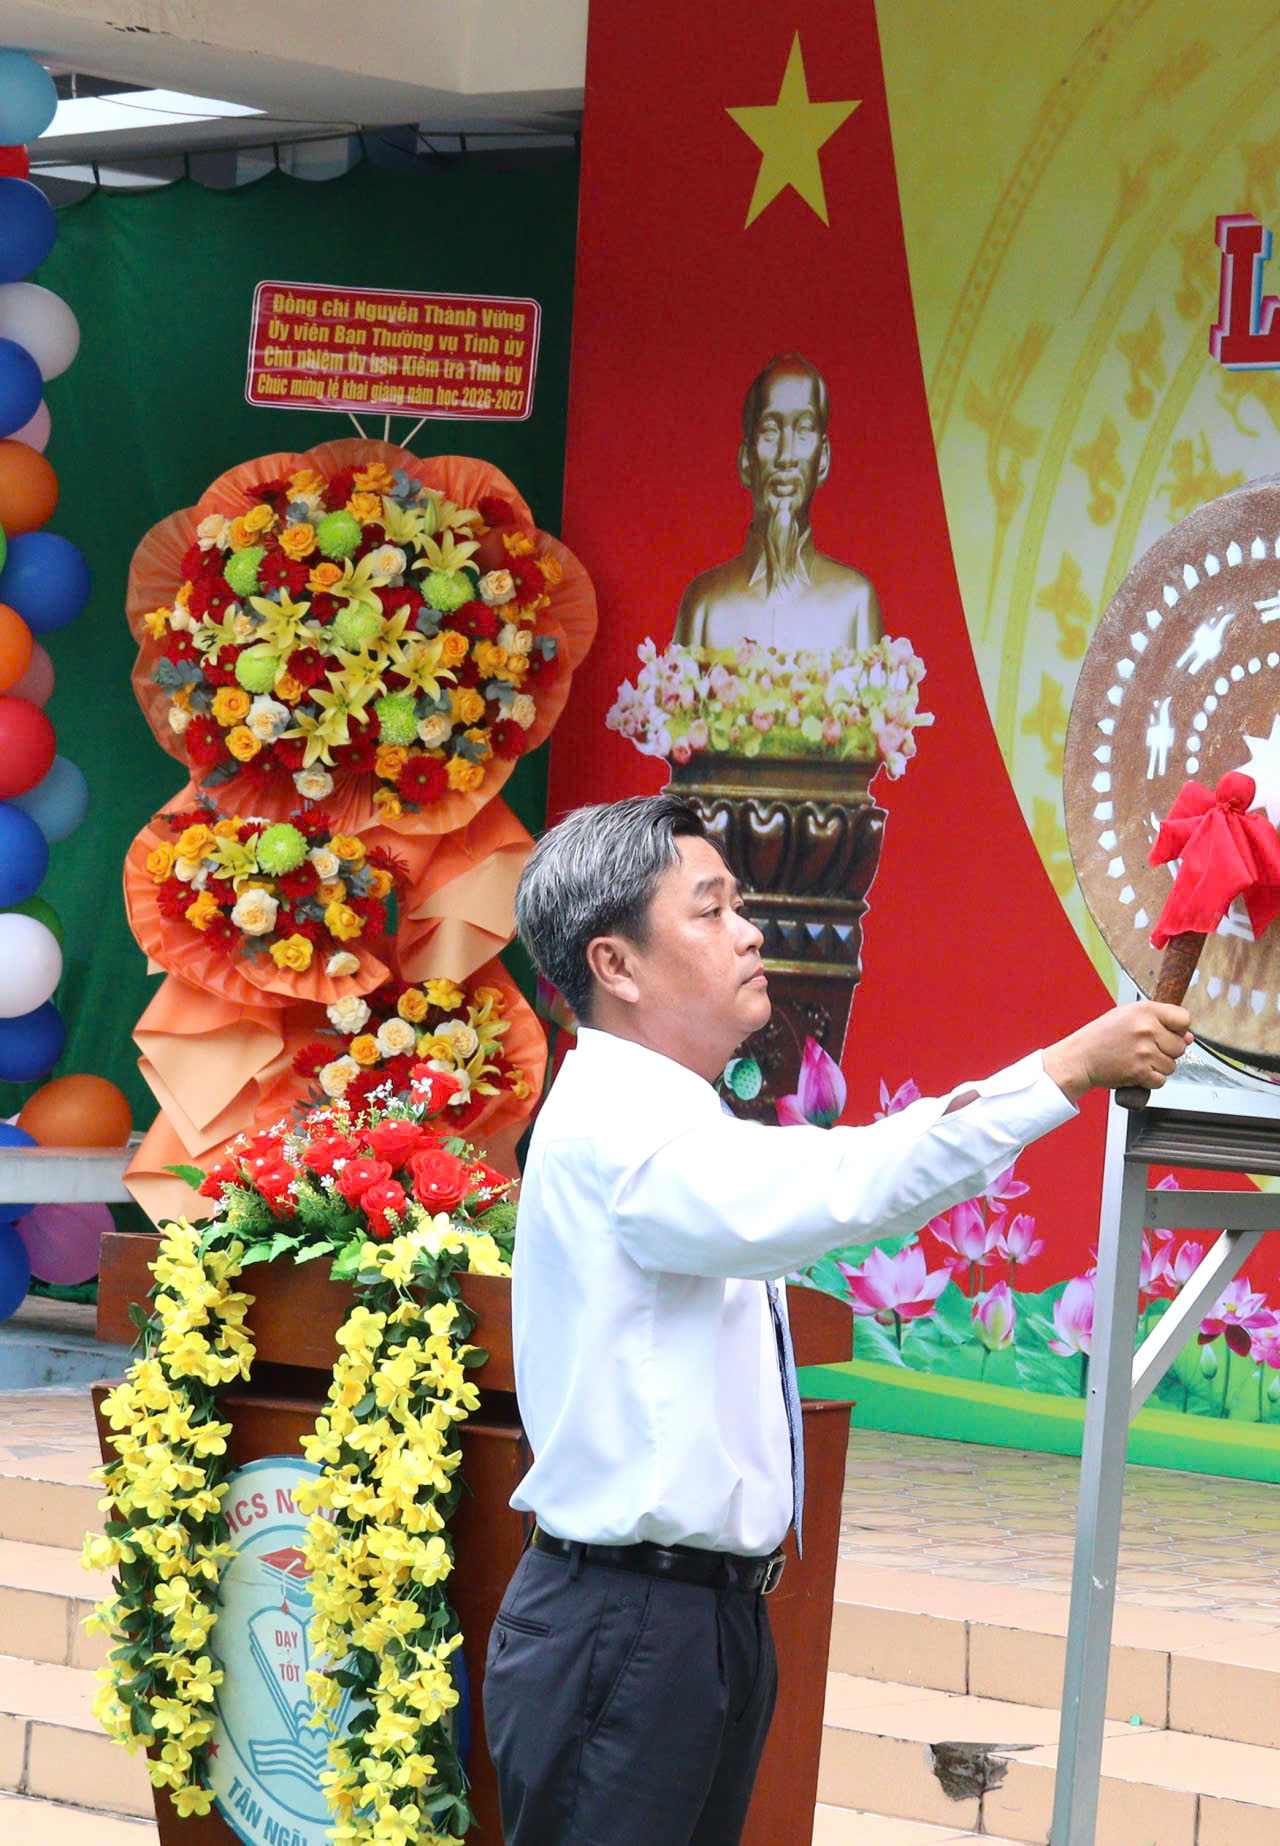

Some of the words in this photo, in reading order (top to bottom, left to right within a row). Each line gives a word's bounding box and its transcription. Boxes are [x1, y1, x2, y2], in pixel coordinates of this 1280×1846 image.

[273, 292, 317, 318] Đồng
[322, 298, 350, 318] chí
[354, 300, 419, 323] Nguyễn
[482, 307, 525, 332] Vững
[269, 315, 289, 341] Ủy
[294, 322, 330, 343] viên
[334, 325, 367, 345] Ban
[372, 327, 434, 352] Thường
[439, 335, 459, 355] vụ
[464, 332, 499, 354] Tỉnh
[504, 335, 525, 358] ủy
[264, 345, 293, 367] Chủ
[297, 347, 344, 374] nhiệm
[348, 346, 367, 375] Ủy
[370, 352, 398, 375] ban
[402, 352, 440, 378] Kiểm
[444, 359, 465, 380] tra
[469, 358, 501, 382] Tỉnh
[504, 360, 523, 385] ủy
[257, 373, 288, 395] Chúc
[290, 376, 325, 401] mừng
[328, 375, 340, 399] lễ
[342, 378, 368, 401] khai
[371, 380, 404, 406] giảng
[407, 384, 434, 405] năm
[436, 386, 459, 411] học
[461, 386, 524, 411] 2026-2027
[228, 1776, 263, 1829] TÂN
